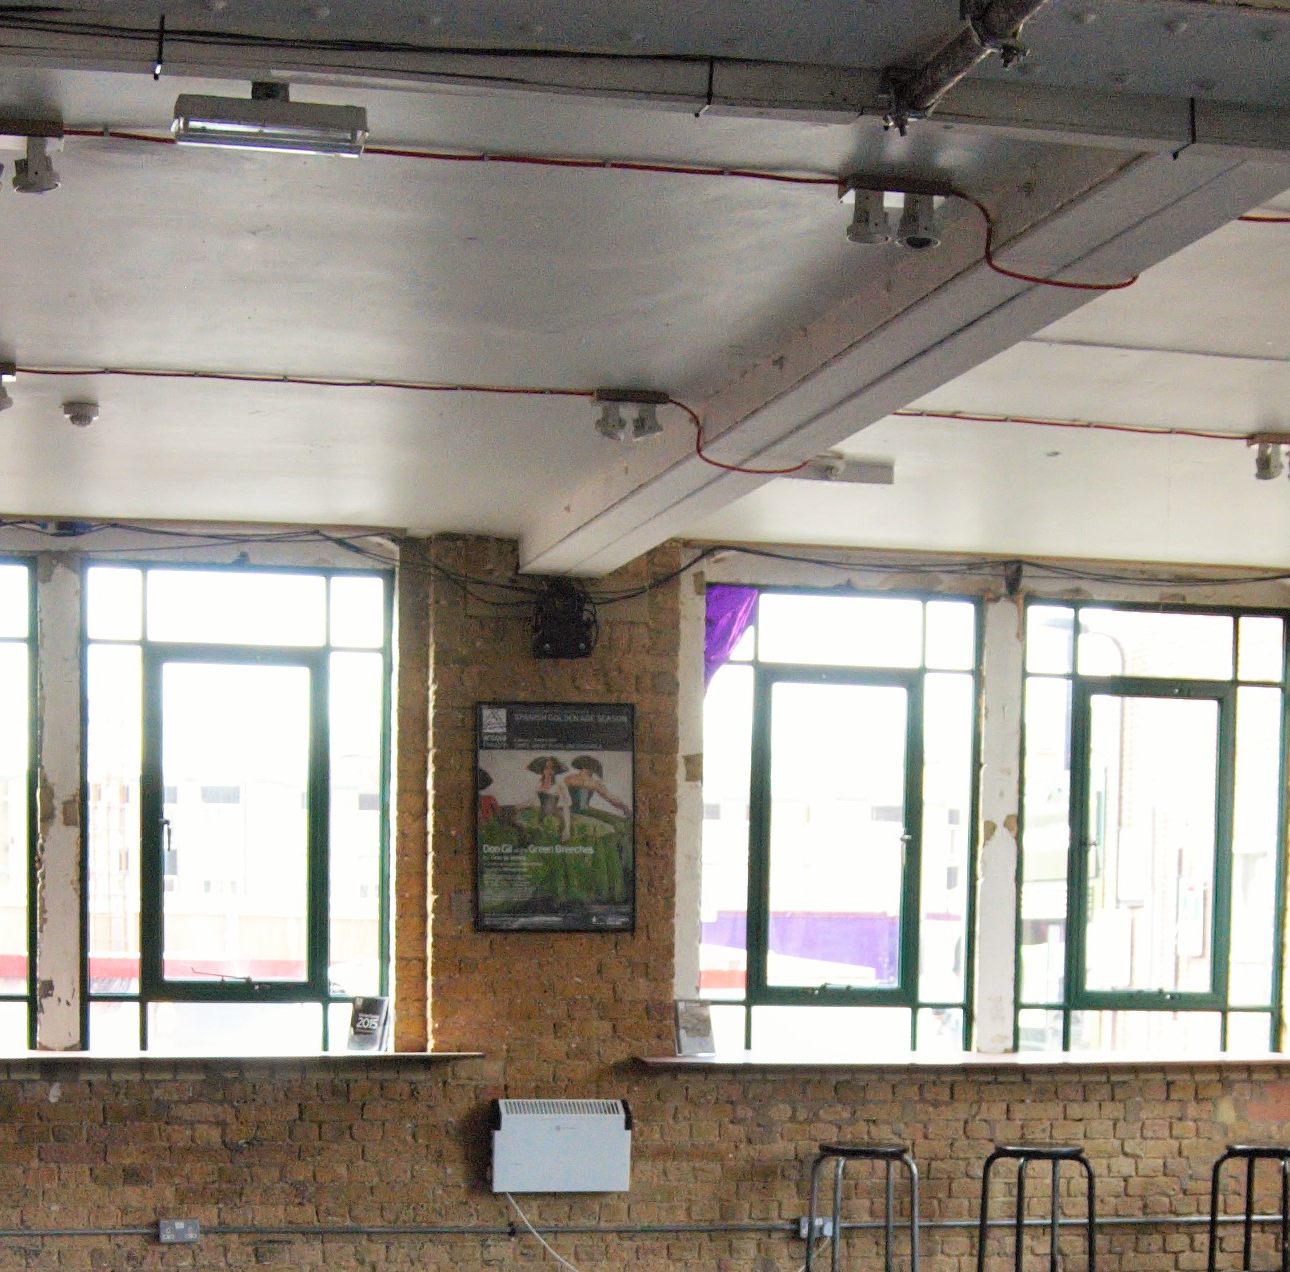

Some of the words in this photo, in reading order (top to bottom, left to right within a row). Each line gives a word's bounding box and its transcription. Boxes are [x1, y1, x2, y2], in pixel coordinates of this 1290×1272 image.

[483, 844, 500, 854] Don
[528, 844, 554, 855] Green
[554, 845, 595, 855] Breeches
[356, 1017, 380, 1029] 2015
